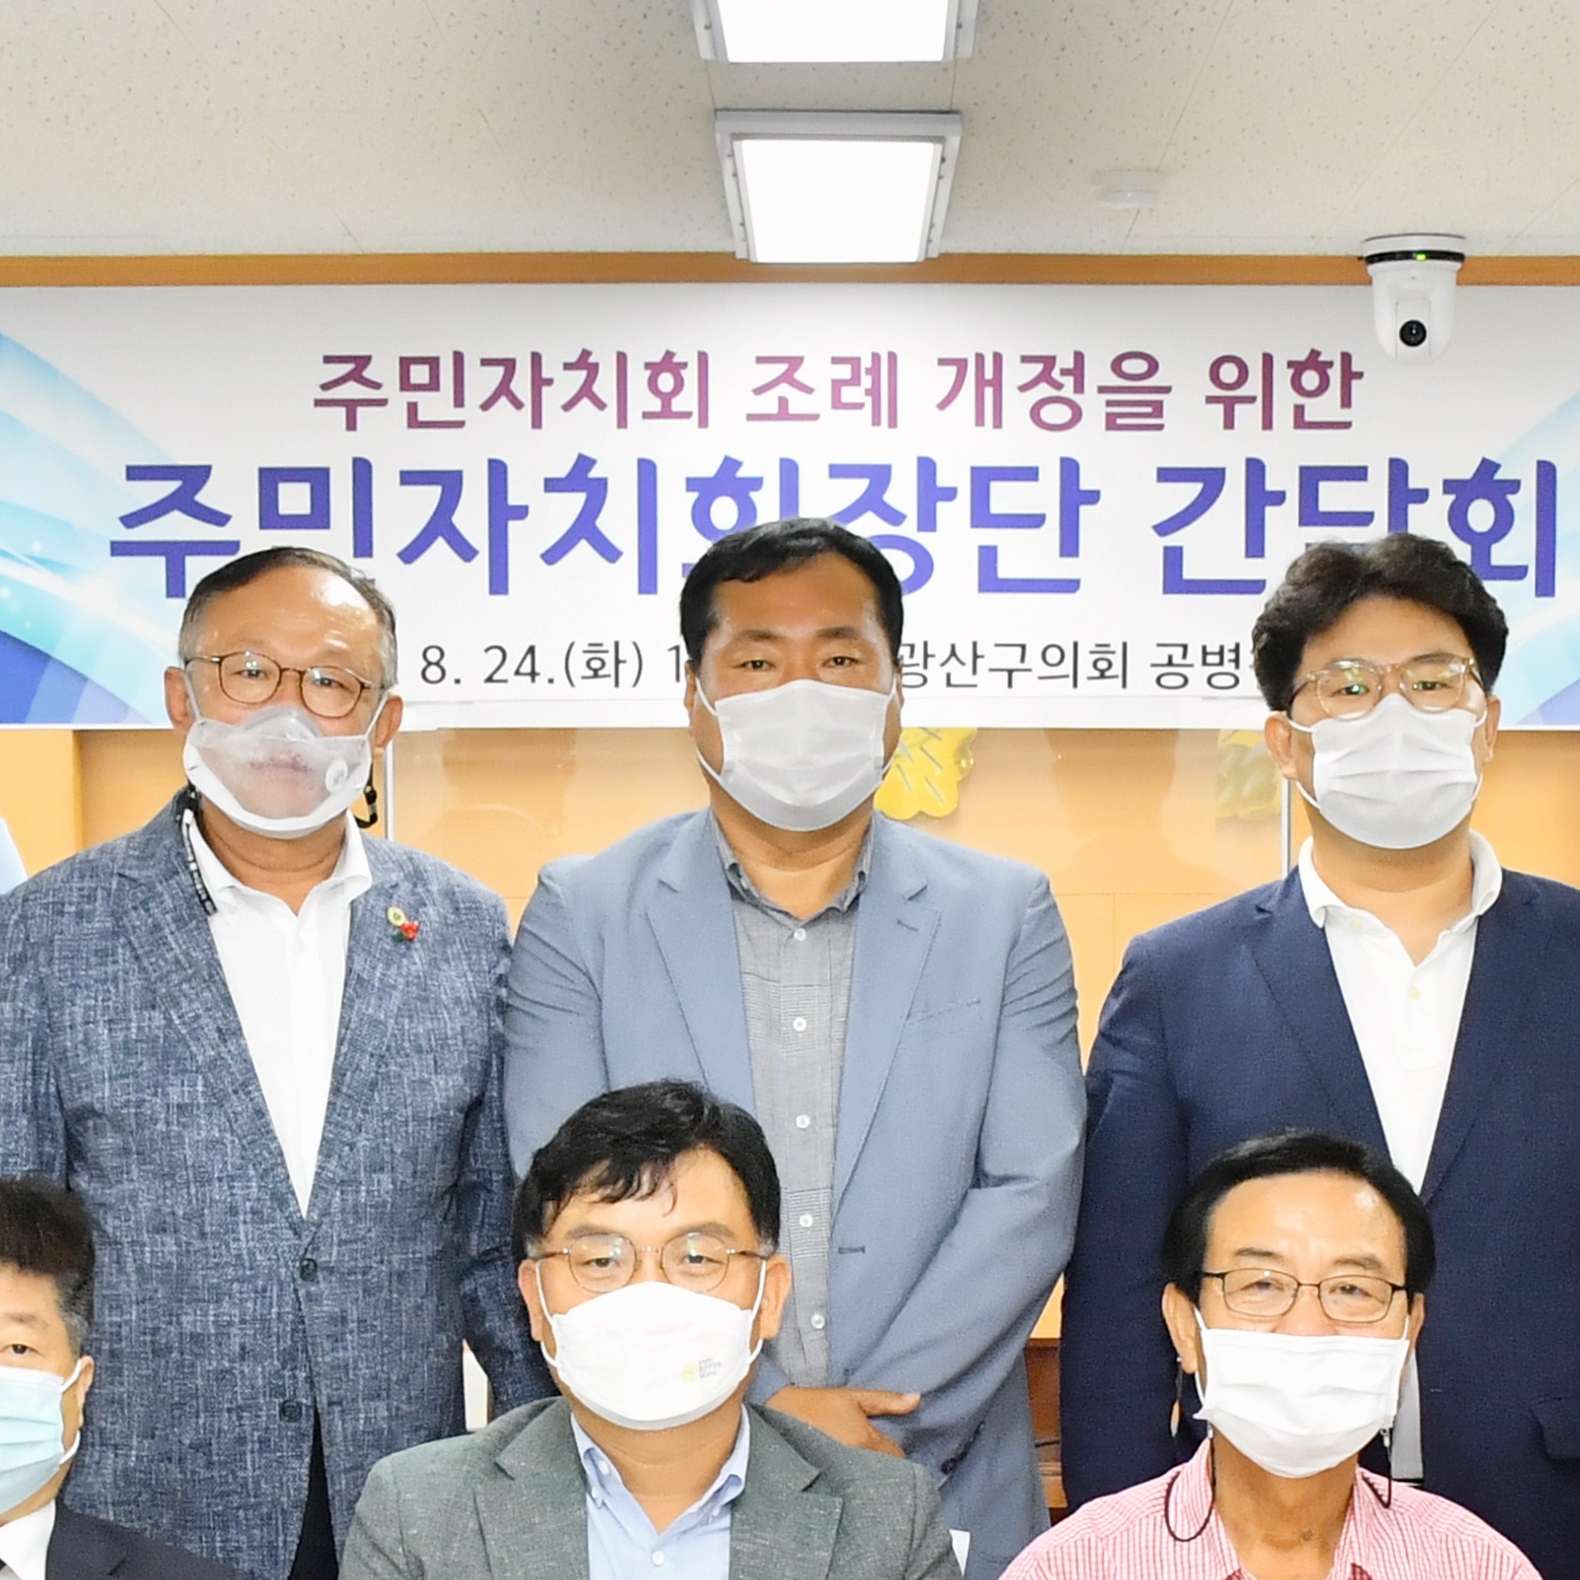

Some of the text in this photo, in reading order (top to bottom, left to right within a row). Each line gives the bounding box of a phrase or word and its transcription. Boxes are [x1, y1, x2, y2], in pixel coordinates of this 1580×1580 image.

[313, 347, 1365, 432] 주민자치회 조례 개정을 위한
[420, 643, 463, 685] 8.
[900, 640, 1129, 690] 광산구의회
[1149, 640, 1257, 691] 공병
